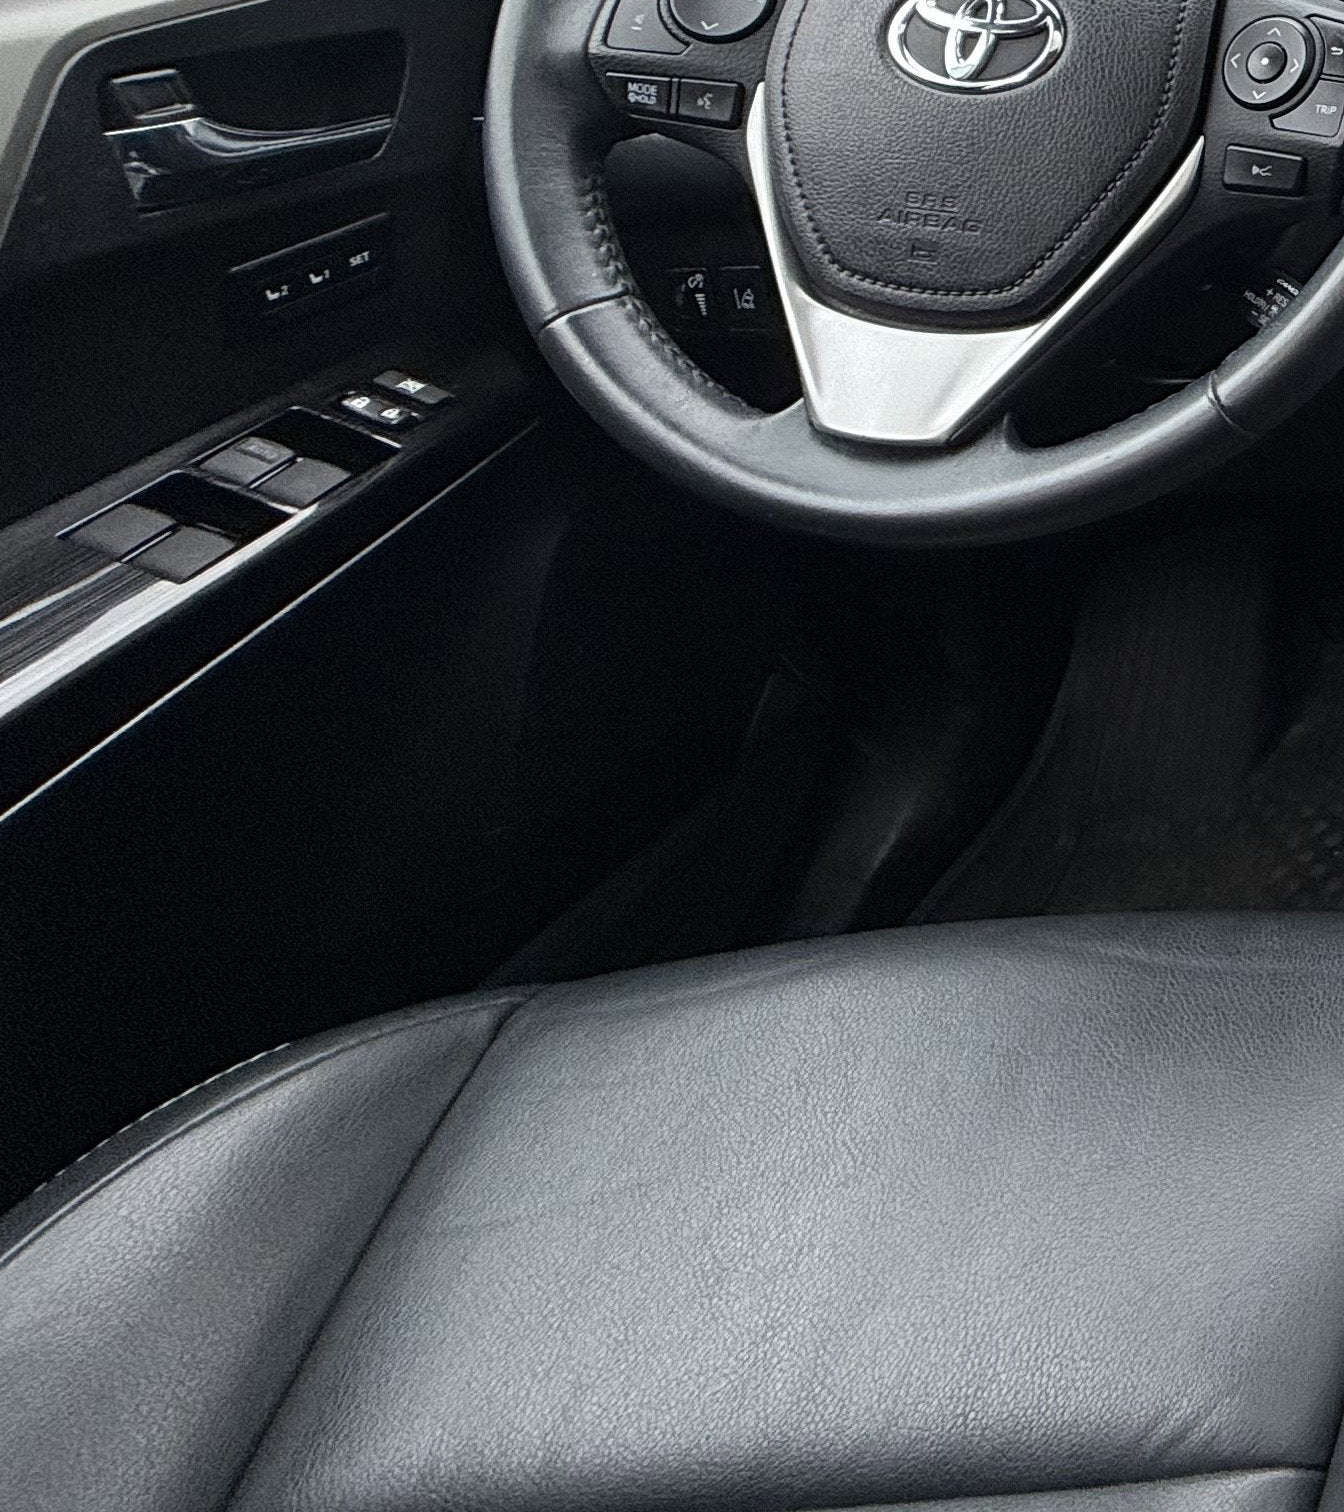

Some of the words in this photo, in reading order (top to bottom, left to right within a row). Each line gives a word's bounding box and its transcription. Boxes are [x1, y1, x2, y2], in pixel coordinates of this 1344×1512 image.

[627, 81, 658, 96] MODE
[1314, 104, 1338, 115] TRIP
[877, 207, 983, 234] AIRBAG
[349, 250, 370, 267] SET
